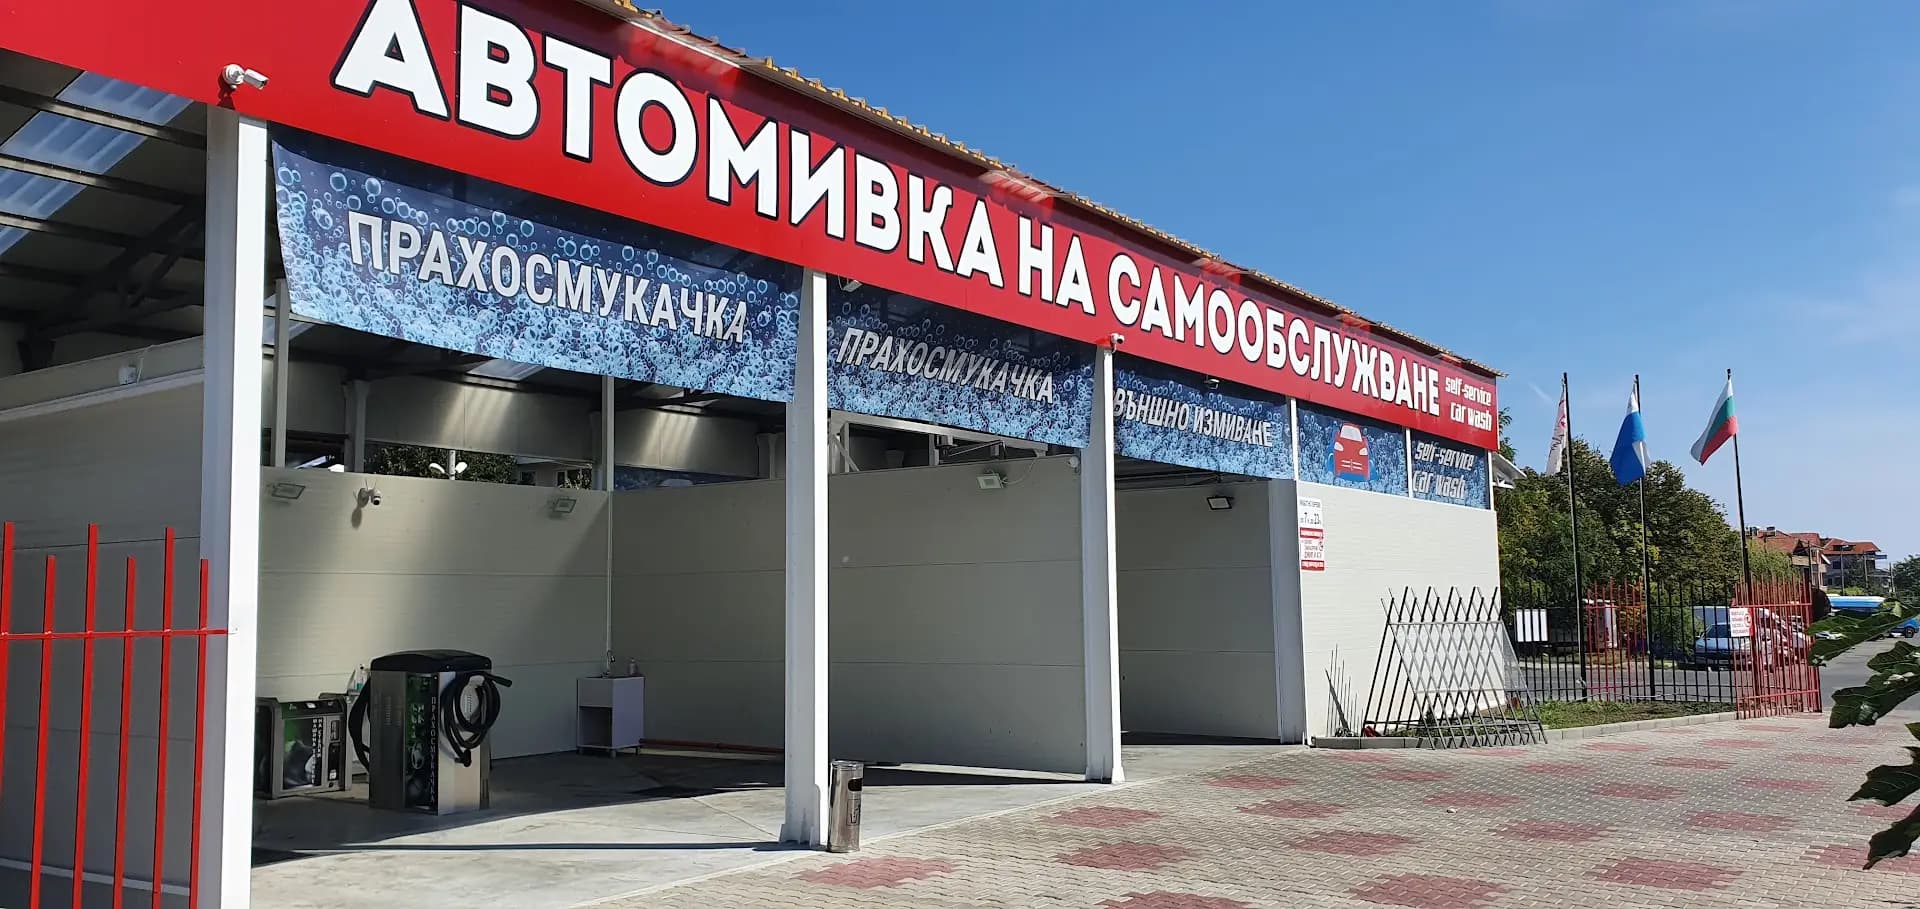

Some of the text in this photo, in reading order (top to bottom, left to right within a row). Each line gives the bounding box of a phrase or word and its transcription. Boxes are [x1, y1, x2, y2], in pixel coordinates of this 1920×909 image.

[331, 0, 1440, 417] АВТОМИВКА НА САМООБСЛУЖВАНЕ
[347, 211, 749, 344] ПРАХОСМУКАЧКА
[836, 327, 1053, 403] ПРАХОСМУКАЧКА
[1445, 376, 1492, 407] self-service
[1113, 387, 1273, 447] ВЪНШНО ИЗМИВАНЕ
[1450, 401, 1492, 431] car wash
[1414, 440, 1475, 471] self-service
[1412, 470, 1467, 500] car wash
